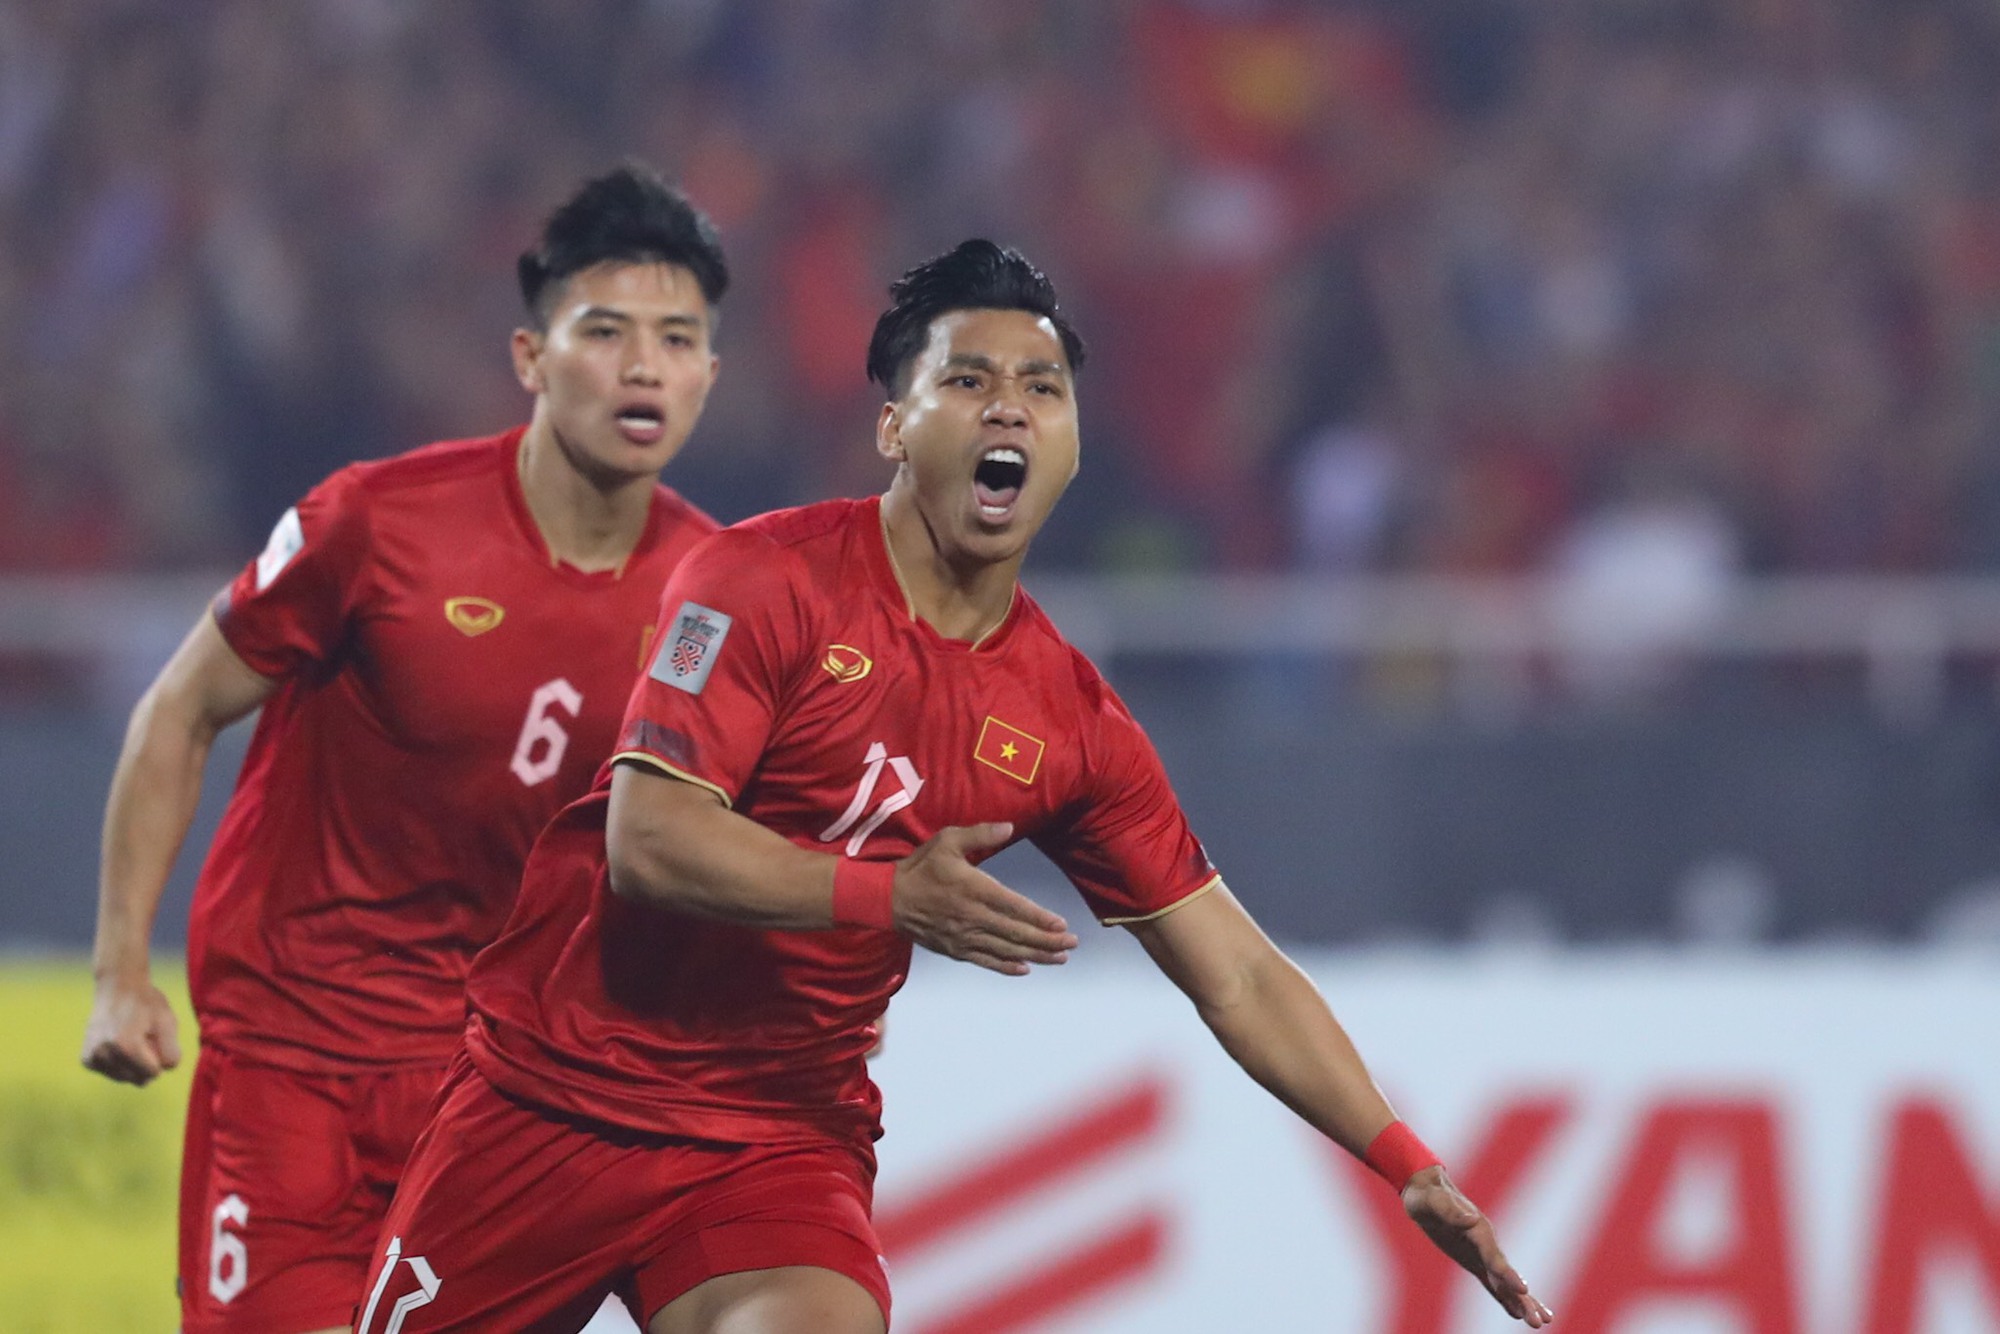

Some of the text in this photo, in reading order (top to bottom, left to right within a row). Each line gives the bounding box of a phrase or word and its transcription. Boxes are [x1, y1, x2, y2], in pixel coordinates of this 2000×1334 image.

[510, 678, 583, 787] 6
[819, 741, 925, 857] 17
[208, 1194, 249, 1304] 6
